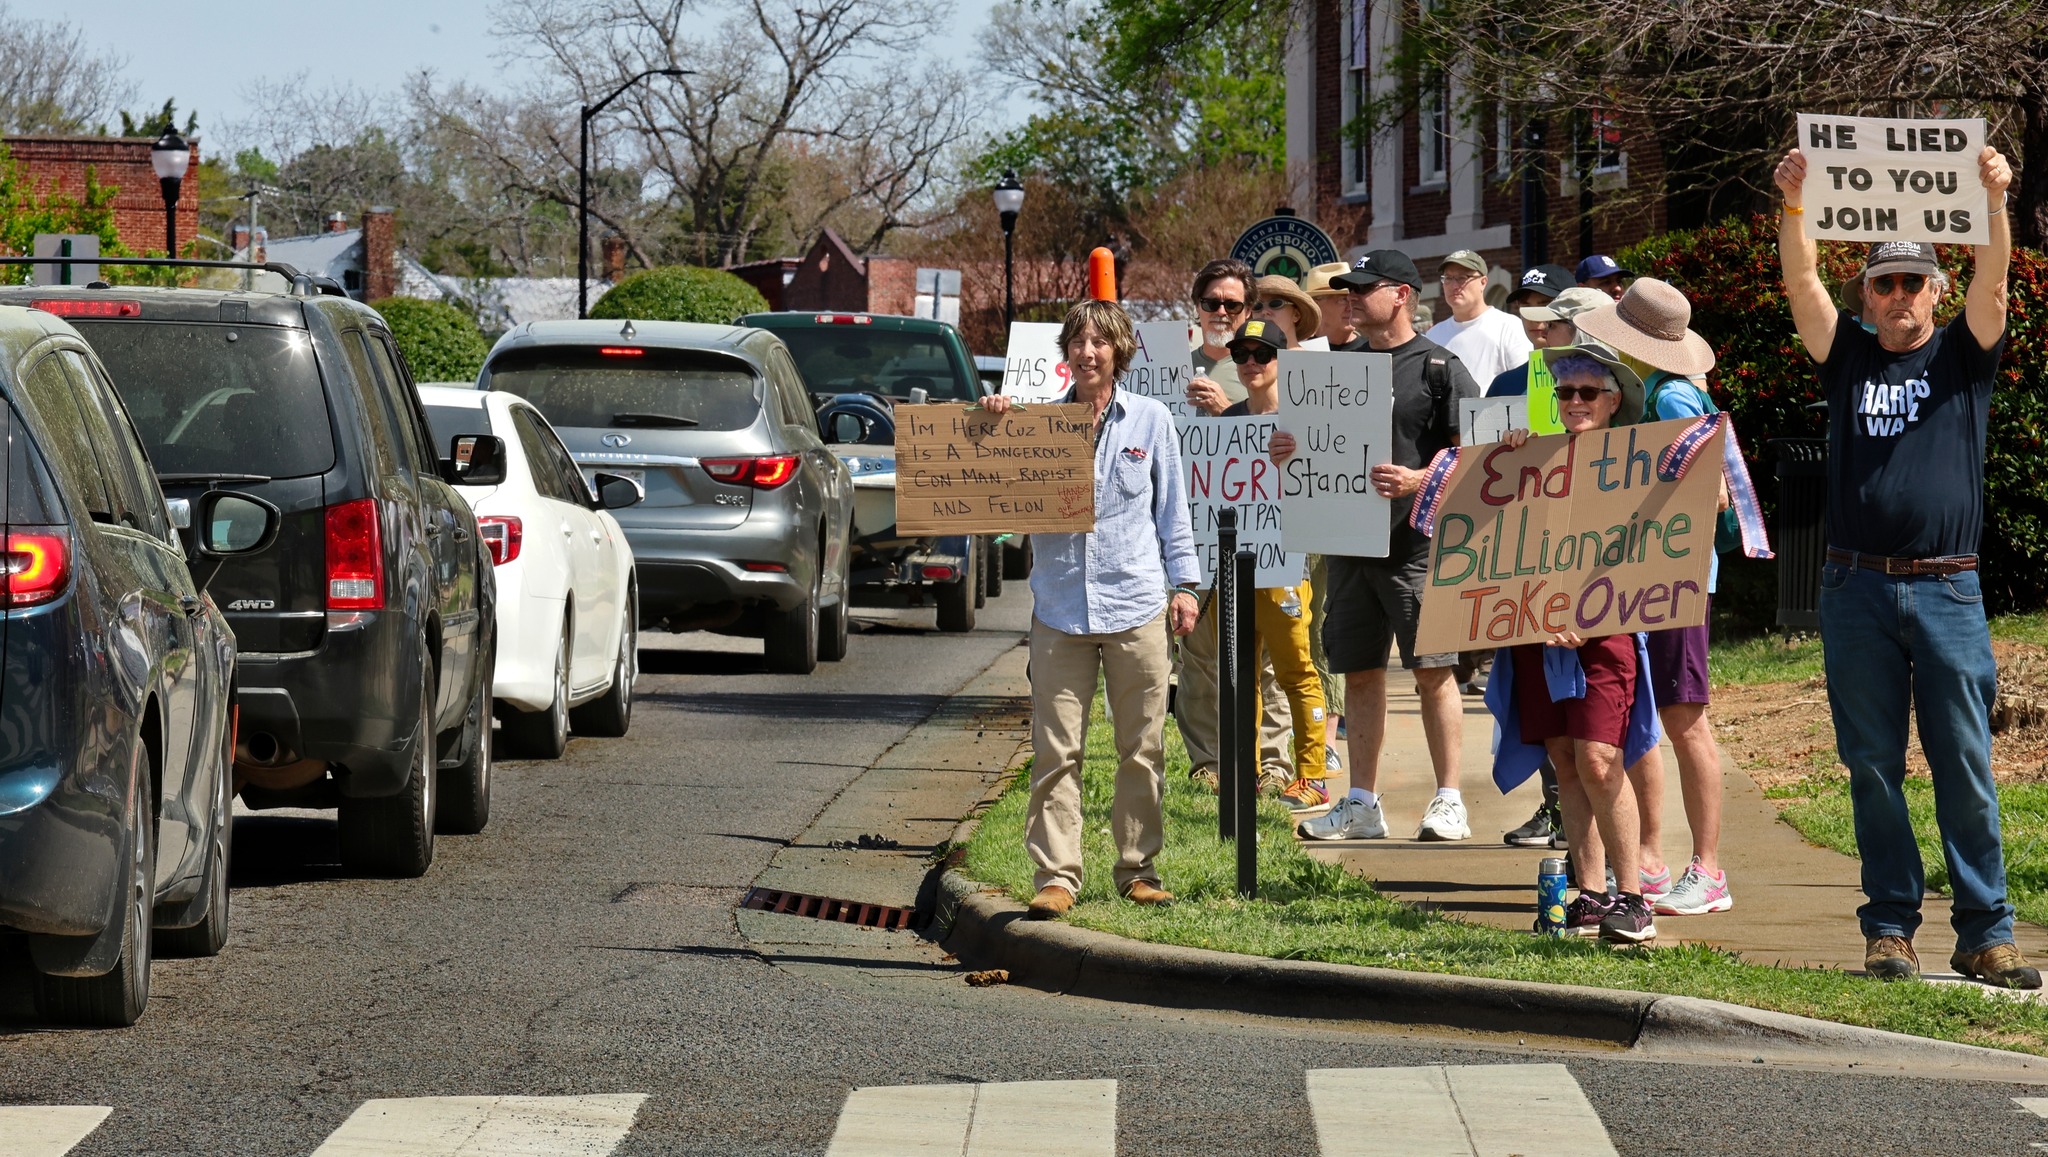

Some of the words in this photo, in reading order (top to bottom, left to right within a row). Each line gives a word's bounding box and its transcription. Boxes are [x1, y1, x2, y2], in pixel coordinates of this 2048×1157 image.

[1809, 123, 1858, 150] HE
[1886, 127, 1968, 153] LIED
[1826, 166, 1873, 192] TO
[1887, 169, 1958, 195] YOU
[1816, 206, 1898, 232] JOIN
[1923, 209, 1972, 233] US
[1239, 223, 1279, 257] ational
[1249, 235, 1316, 260] PITTSBORO
[1004, 357, 1047, 387] HAS
[1119, 365, 1190, 396] ROBLEMS
[1287, 365, 1369, 410] United
[910, 415, 934, 436] I'M
[953, 417, 1000, 438] HERE
[1040, 415, 1093, 439] TRUMP
[1176, 425, 1220, 457] YOU
[1307, 423, 1346, 454] We
[913, 444, 931, 461] IS
[947, 443, 961, 460] A
[975, 442, 1072, 459] DANGEROUS
[914, 470, 951, 487] CON
[1020, 467, 1076, 485] RAPIST
[1191, 458, 1282, 501] NGRY
[1284, 444, 1369, 498] Stand
[1480, 434, 1576, 507] End
[933, 500, 972, 517] AND
[988, 495, 1044, 514] FELON
[228, 600, 275, 610] 4WD
